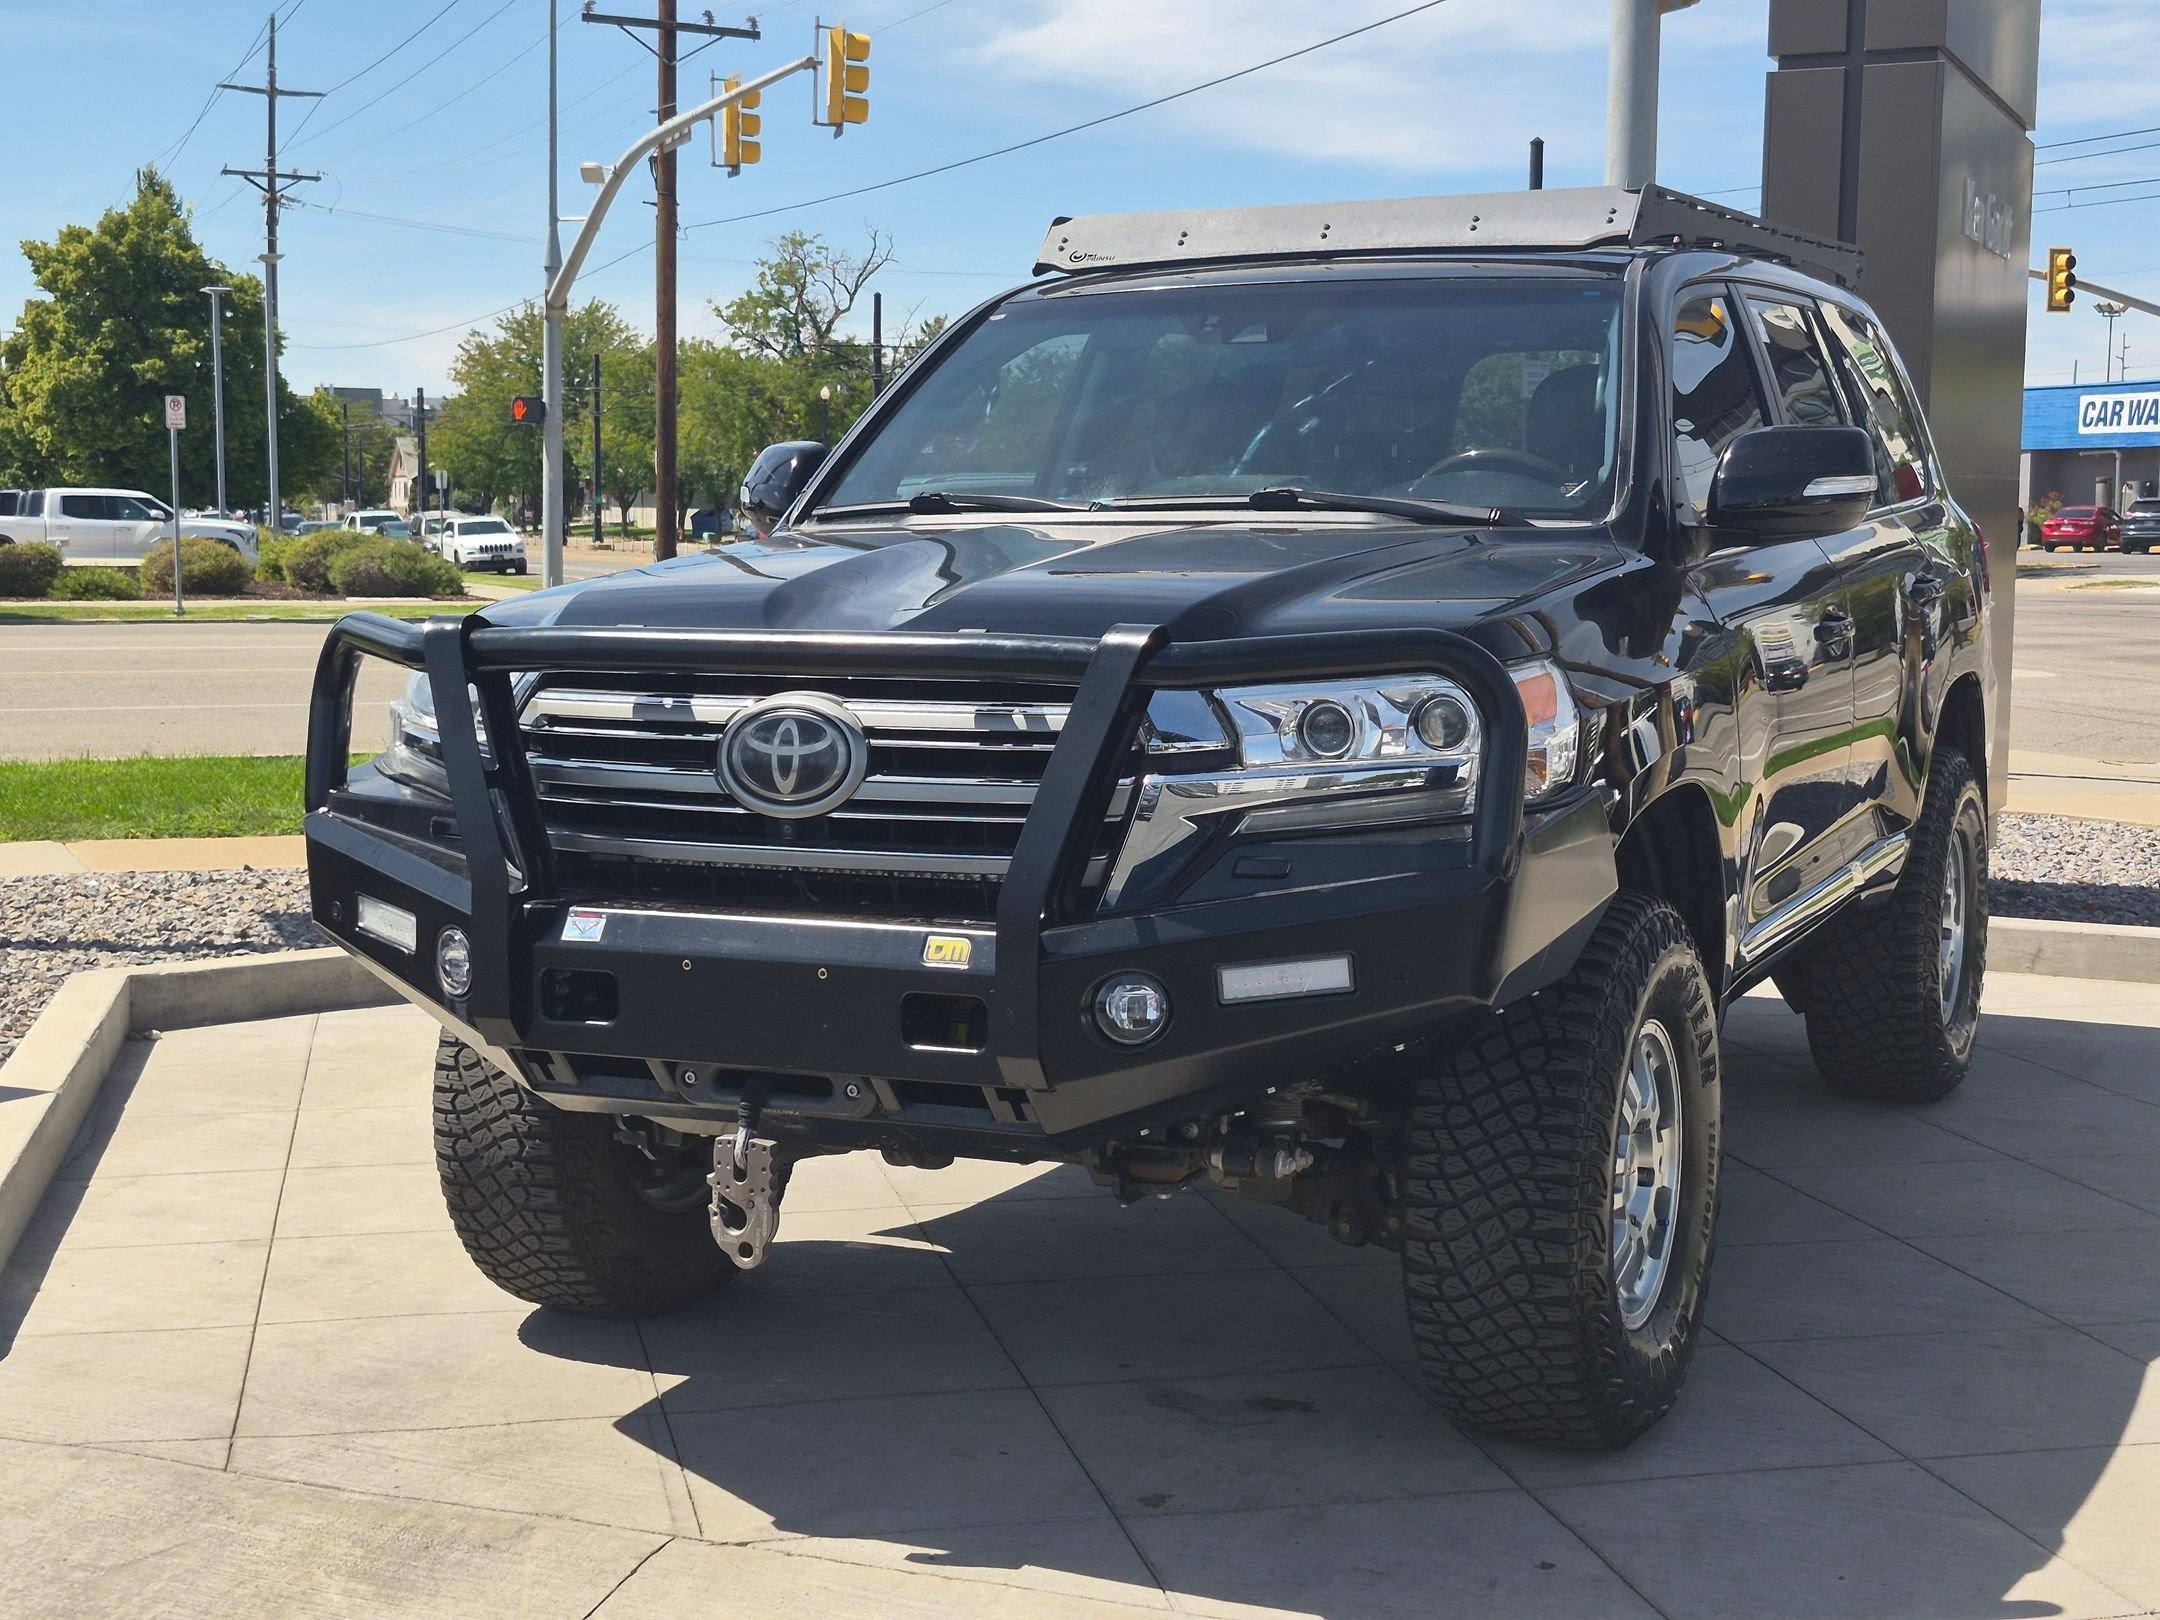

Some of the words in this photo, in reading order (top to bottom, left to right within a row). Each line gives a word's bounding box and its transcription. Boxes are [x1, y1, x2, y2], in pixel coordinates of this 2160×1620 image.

[2082, 400, 2125, 428] CAR
[2127, 398, 2160, 426] WA
[1700, 1119, 1716, 1246] TERRITORY
